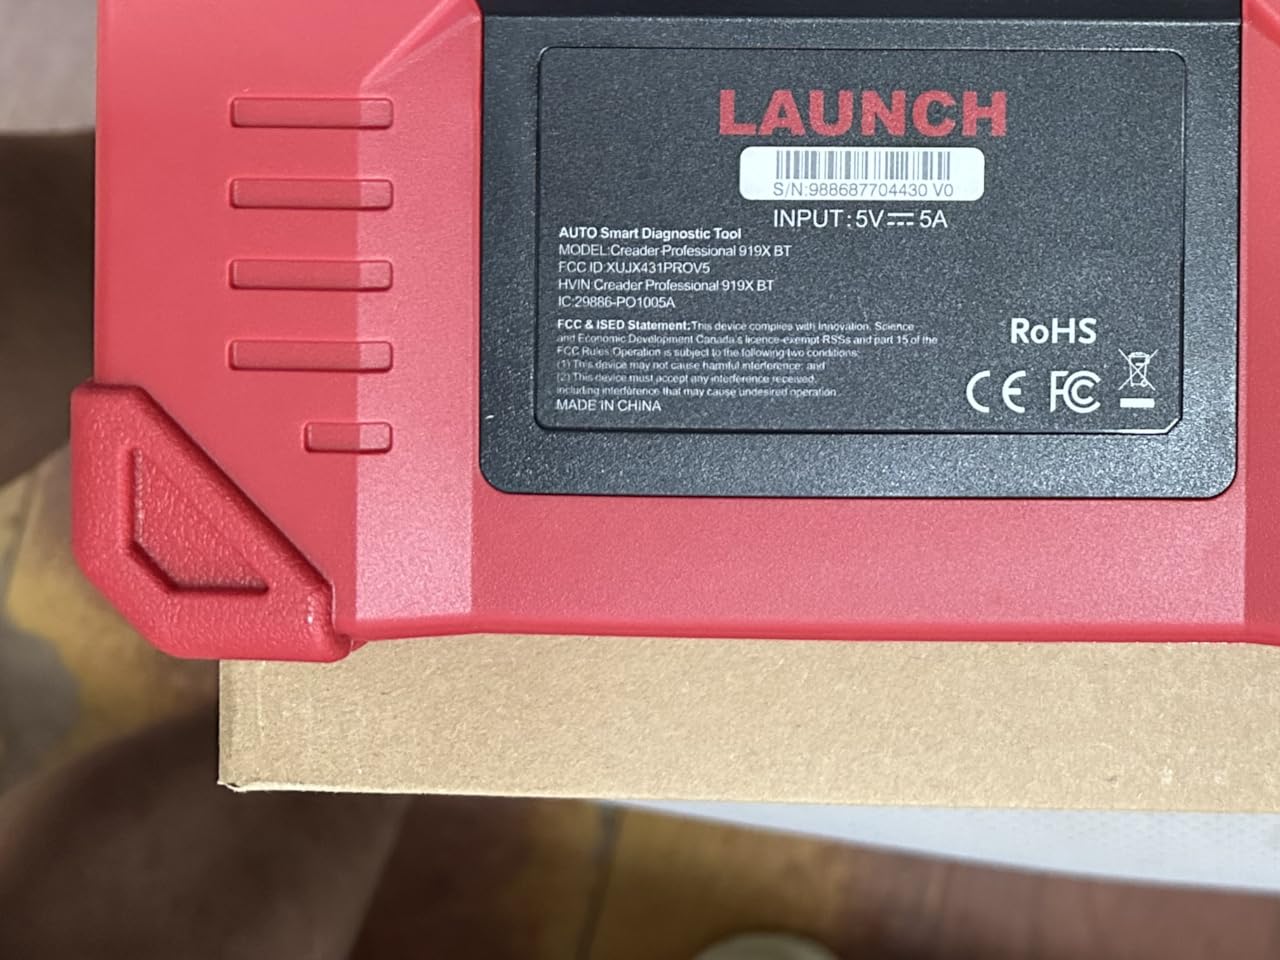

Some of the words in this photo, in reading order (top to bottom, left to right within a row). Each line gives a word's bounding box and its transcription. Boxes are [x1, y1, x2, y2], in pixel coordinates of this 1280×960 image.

[719, 89, 1007, 137] LAUNCH
[773, 182, 928, 197] S/N:988687704430
[933, 183, 954, 197] V0
[919, 209, 948, 228] 5A
[559, 227, 598, 239] AUTO
[600, 227, 639, 239] Smart
[641, 227, 711, 241] Diagnostic
[713, 227, 742, 239] Tool
[662, 244, 737, 257] Professional
[738, 245, 772, 257] 919X
[774, 245, 792, 257] BT
[558, 261, 587, 273] FCC
[645, 279, 720, 292] Professional
[721, 279, 754, 292] 919X
[756, 279, 774, 292] BT
[557, 319, 582, 330] FCC
[585, 319, 594, 330] &
[596, 319, 625, 330] ISED
[714, 321, 747, 331] device
[748, 322, 793, 332] complies
[795, 322, 816, 331] with
[1010, 317, 1097, 344] RoHS
[628, 334, 694, 345] Development
[853, 335, 872, 345] and
[896, 335, 909, 345] 15
[910, 336, 921, 345] of
[557, 346, 580, 356] FCC
[674, 348, 710, 359] subject
[711, 348, 722, 357] to
[723, 348, 740, 357] the
[741, 348, 785, 359] following
[787, 348, 805, 357] two
[629, 361, 650, 372] may
[652, 361, 669, 370] not
[670, 362, 701, 371] cause
[806, 361, 826, 371] and
[629, 374, 653, 383] must
[662, 387, 681, 397] that
[683, 388, 704, 398] may
[706, 388, 737, 397] cause
[556, 399, 597, 411] MADE
[599, 400, 615, 411] IN
[617, 400, 662, 412] CHINA
